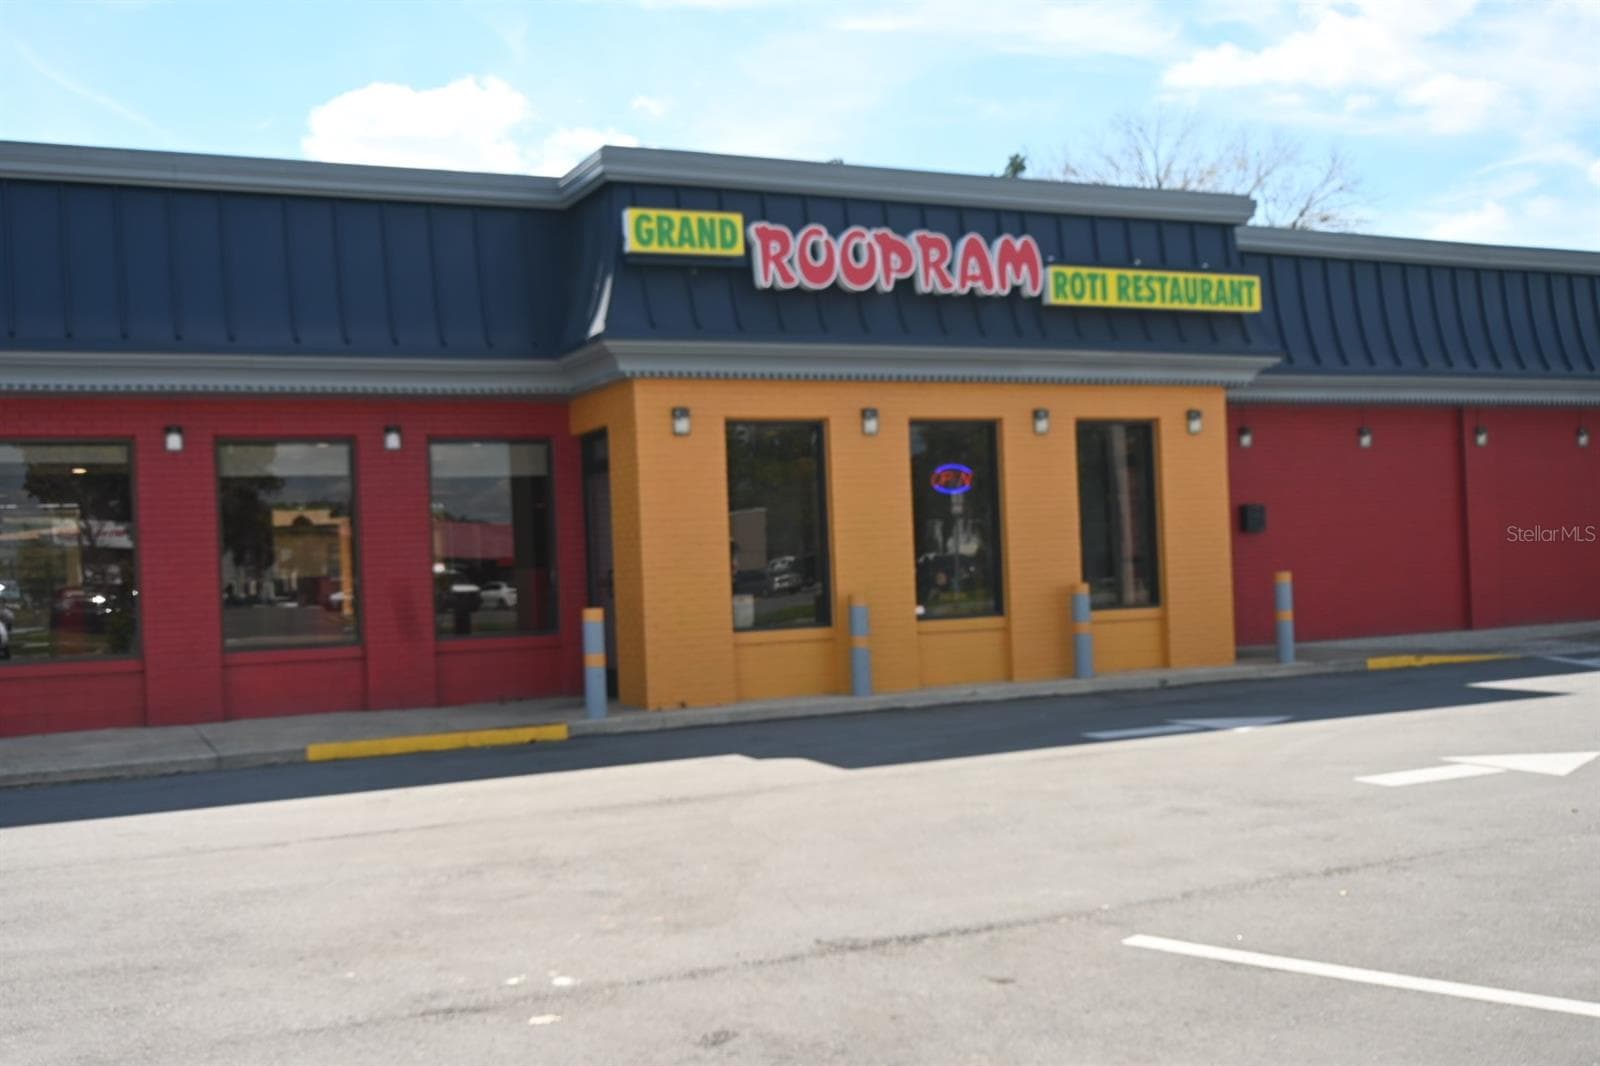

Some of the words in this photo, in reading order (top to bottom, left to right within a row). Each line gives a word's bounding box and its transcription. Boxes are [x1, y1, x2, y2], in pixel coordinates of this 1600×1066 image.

[634, 213, 738, 250] GRAND
[749, 222, 1043, 296] ROOPRAM
[1053, 271, 1108, 302] ROTI
[1116, 273, 1256, 308] RESTAURANT
